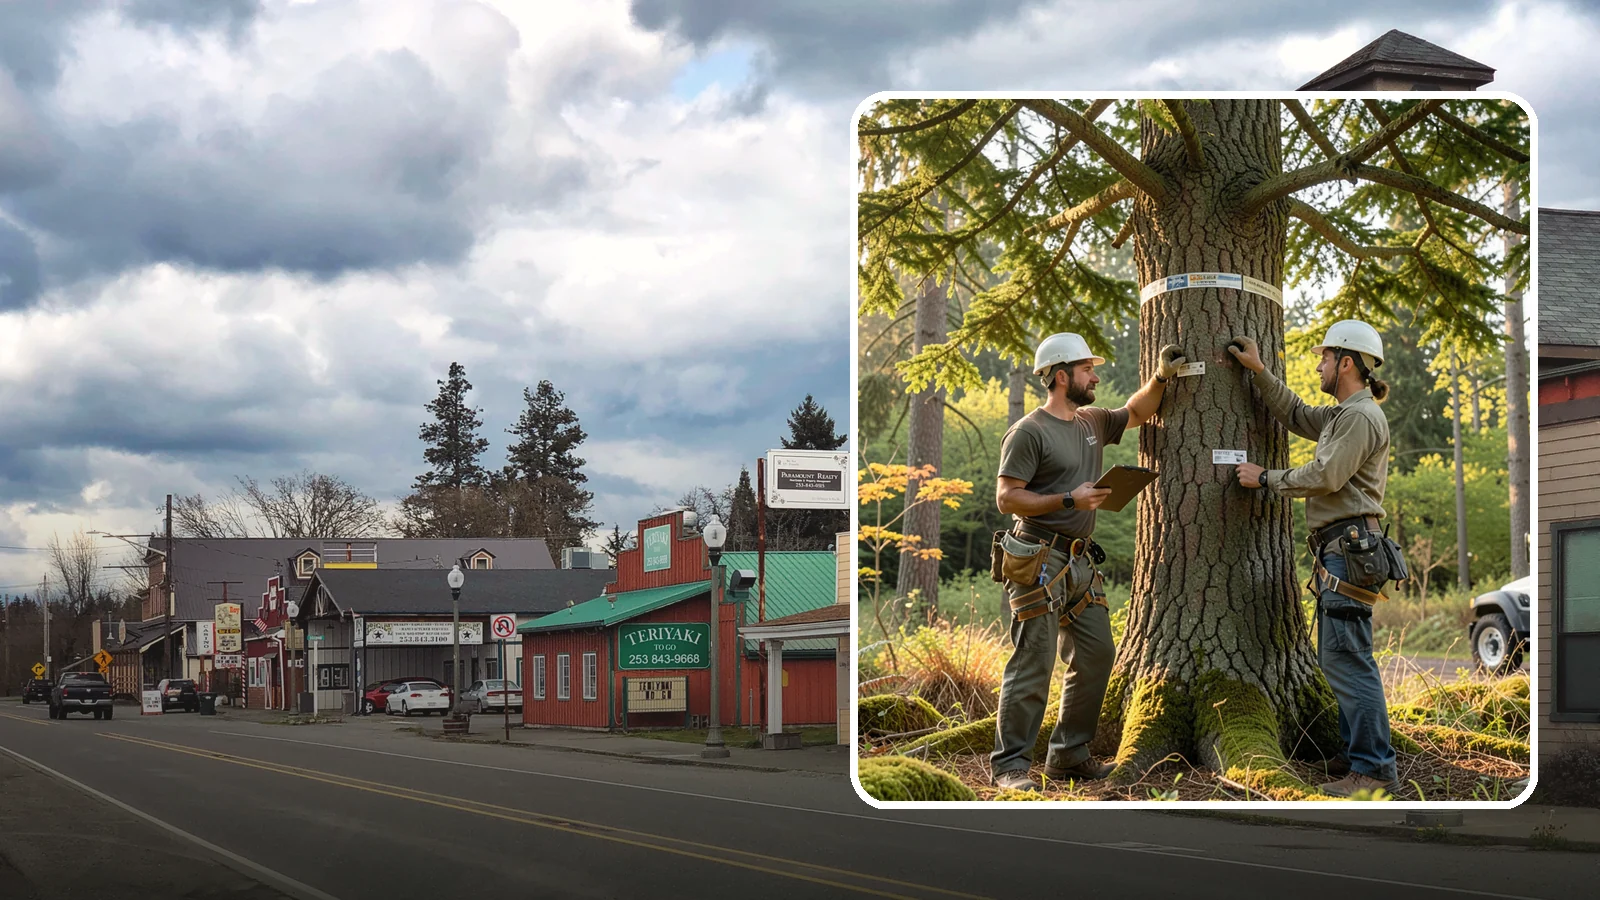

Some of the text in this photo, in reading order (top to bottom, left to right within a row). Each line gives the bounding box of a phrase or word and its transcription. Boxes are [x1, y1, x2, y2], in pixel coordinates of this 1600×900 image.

[624, 627, 702, 646] TERIYAKI
[628, 653, 700, 665] 253 843-9668
